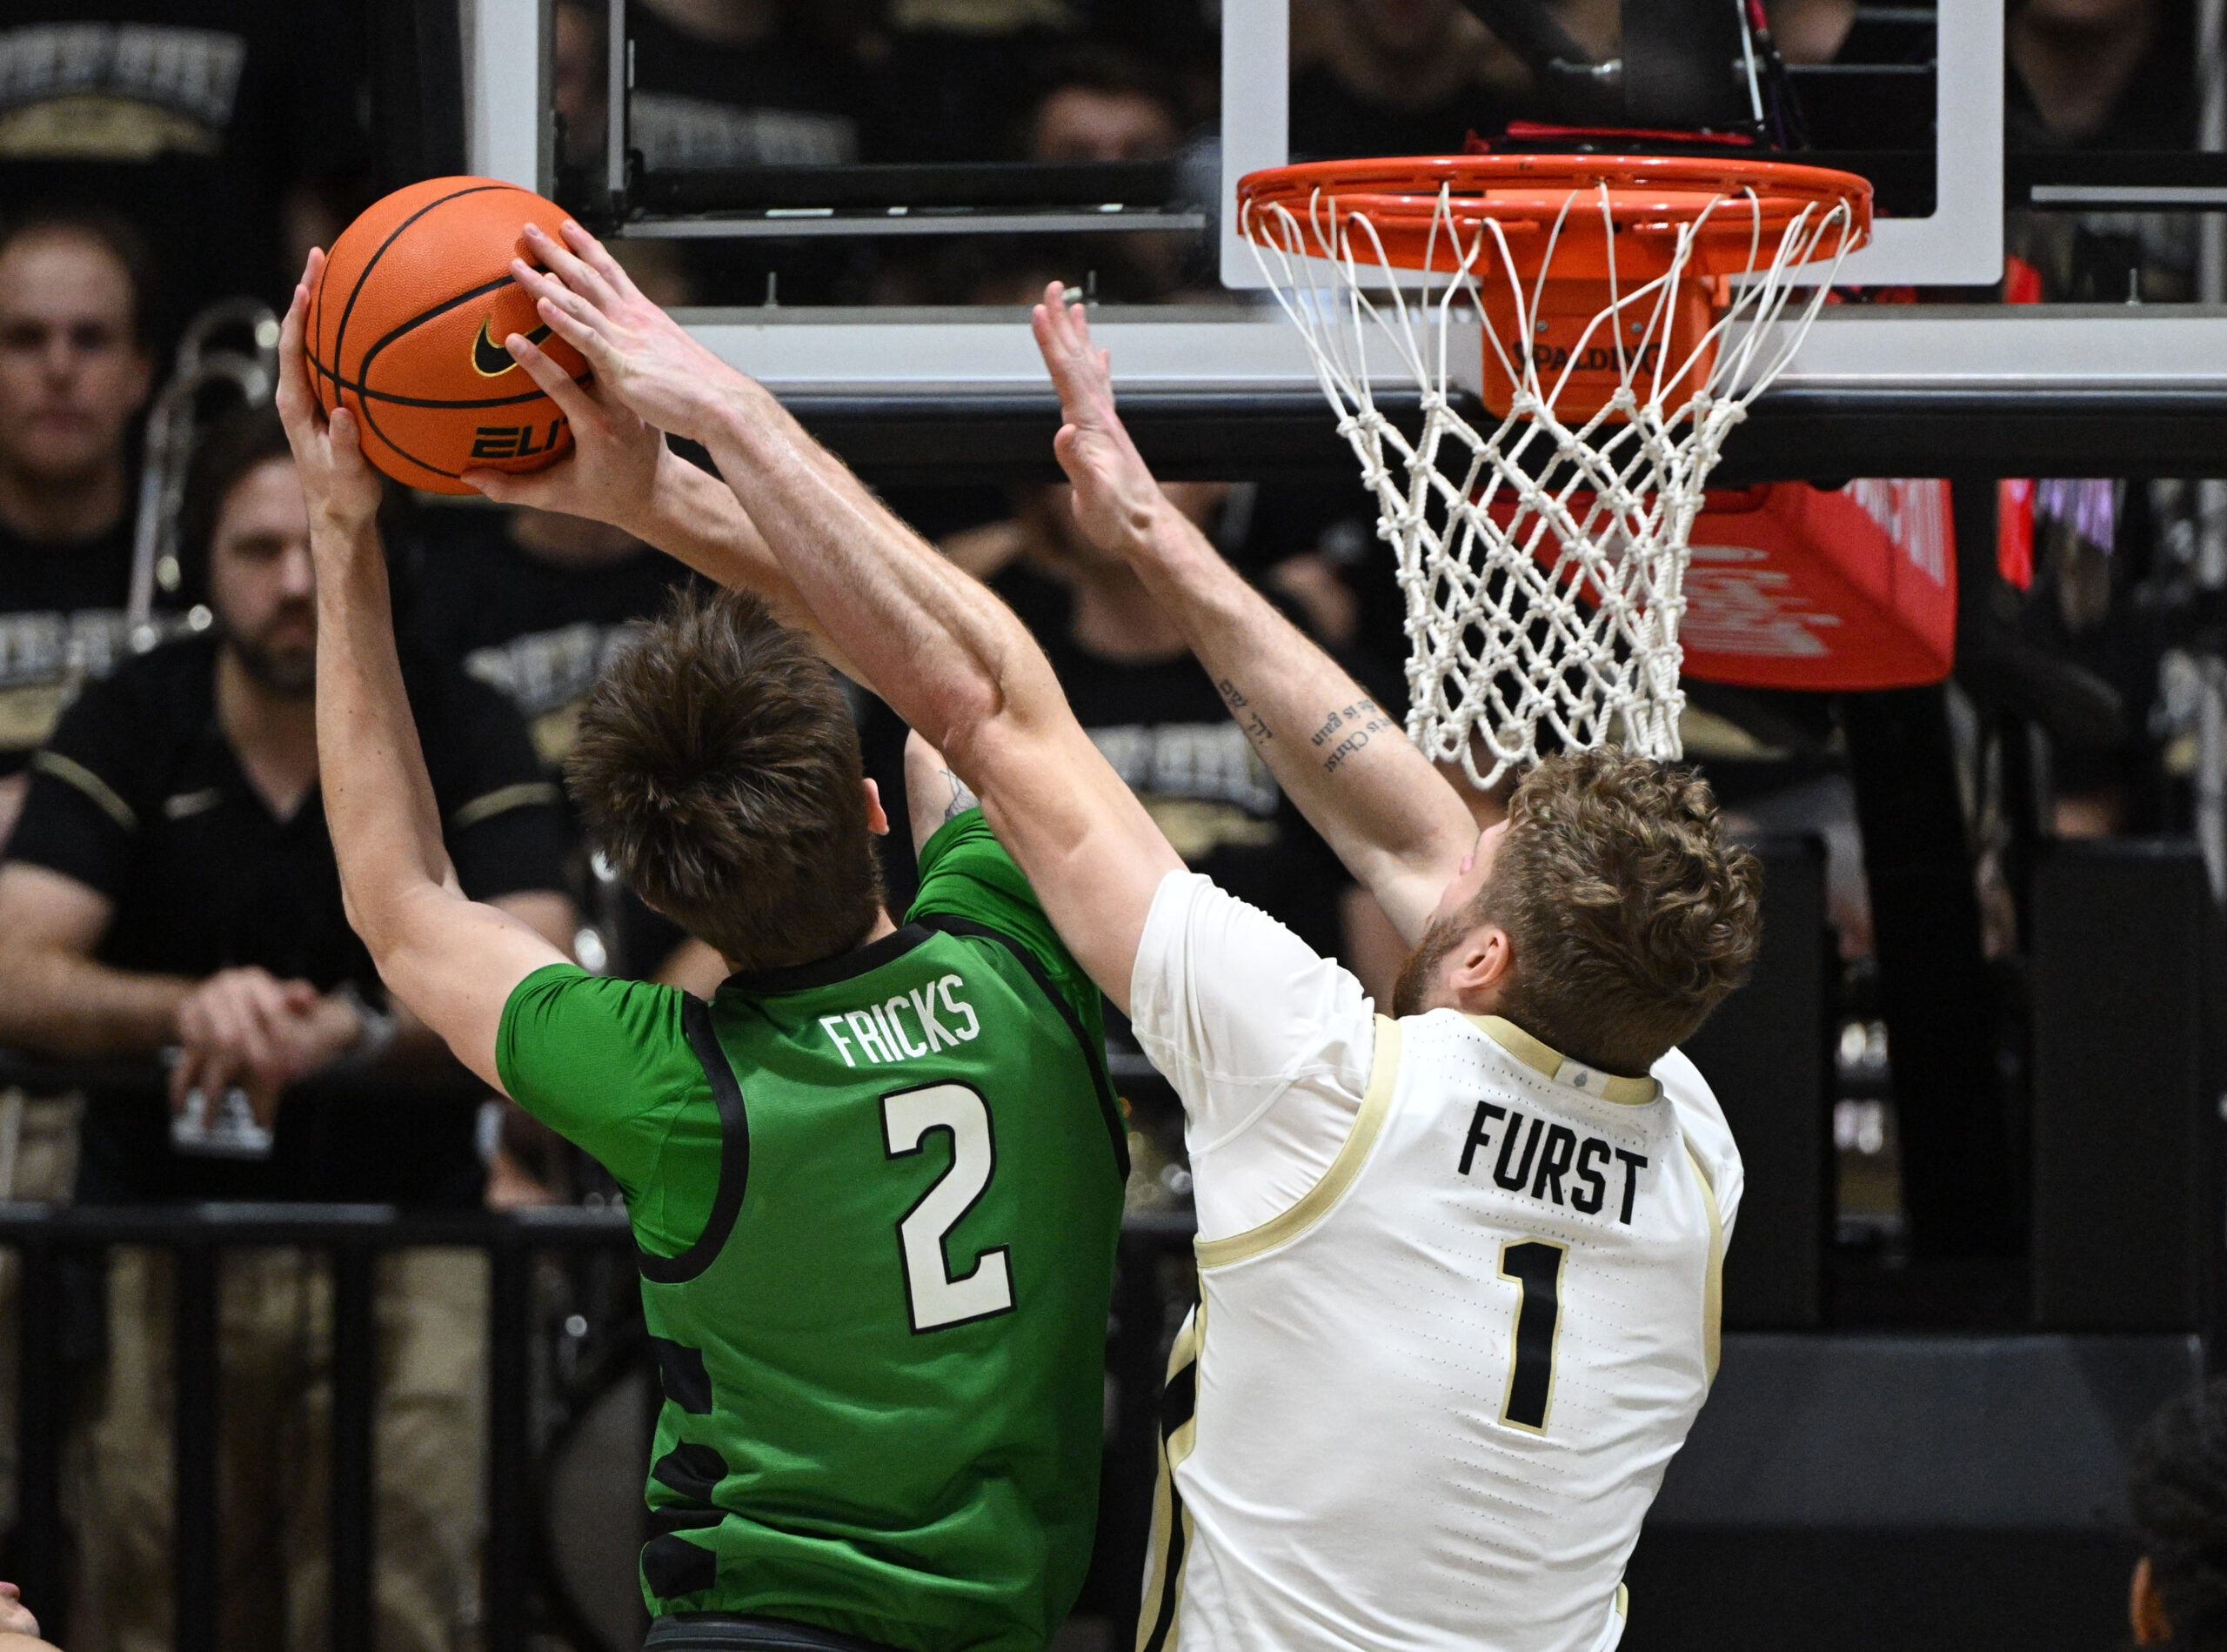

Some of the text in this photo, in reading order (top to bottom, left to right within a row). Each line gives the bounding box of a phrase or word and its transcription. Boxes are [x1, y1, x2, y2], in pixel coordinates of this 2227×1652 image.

[471, 415, 569, 458] ELI
[1310, 712, 1343, 746] gain
[1323, 731, 1369, 773] Christ
[819, 973, 980, 1067] FRICKS
[879, 1078, 1017, 1335] 2
[1457, 1100, 1649, 1226] FURST
[1496, 1235, 1569, 1437] 1
